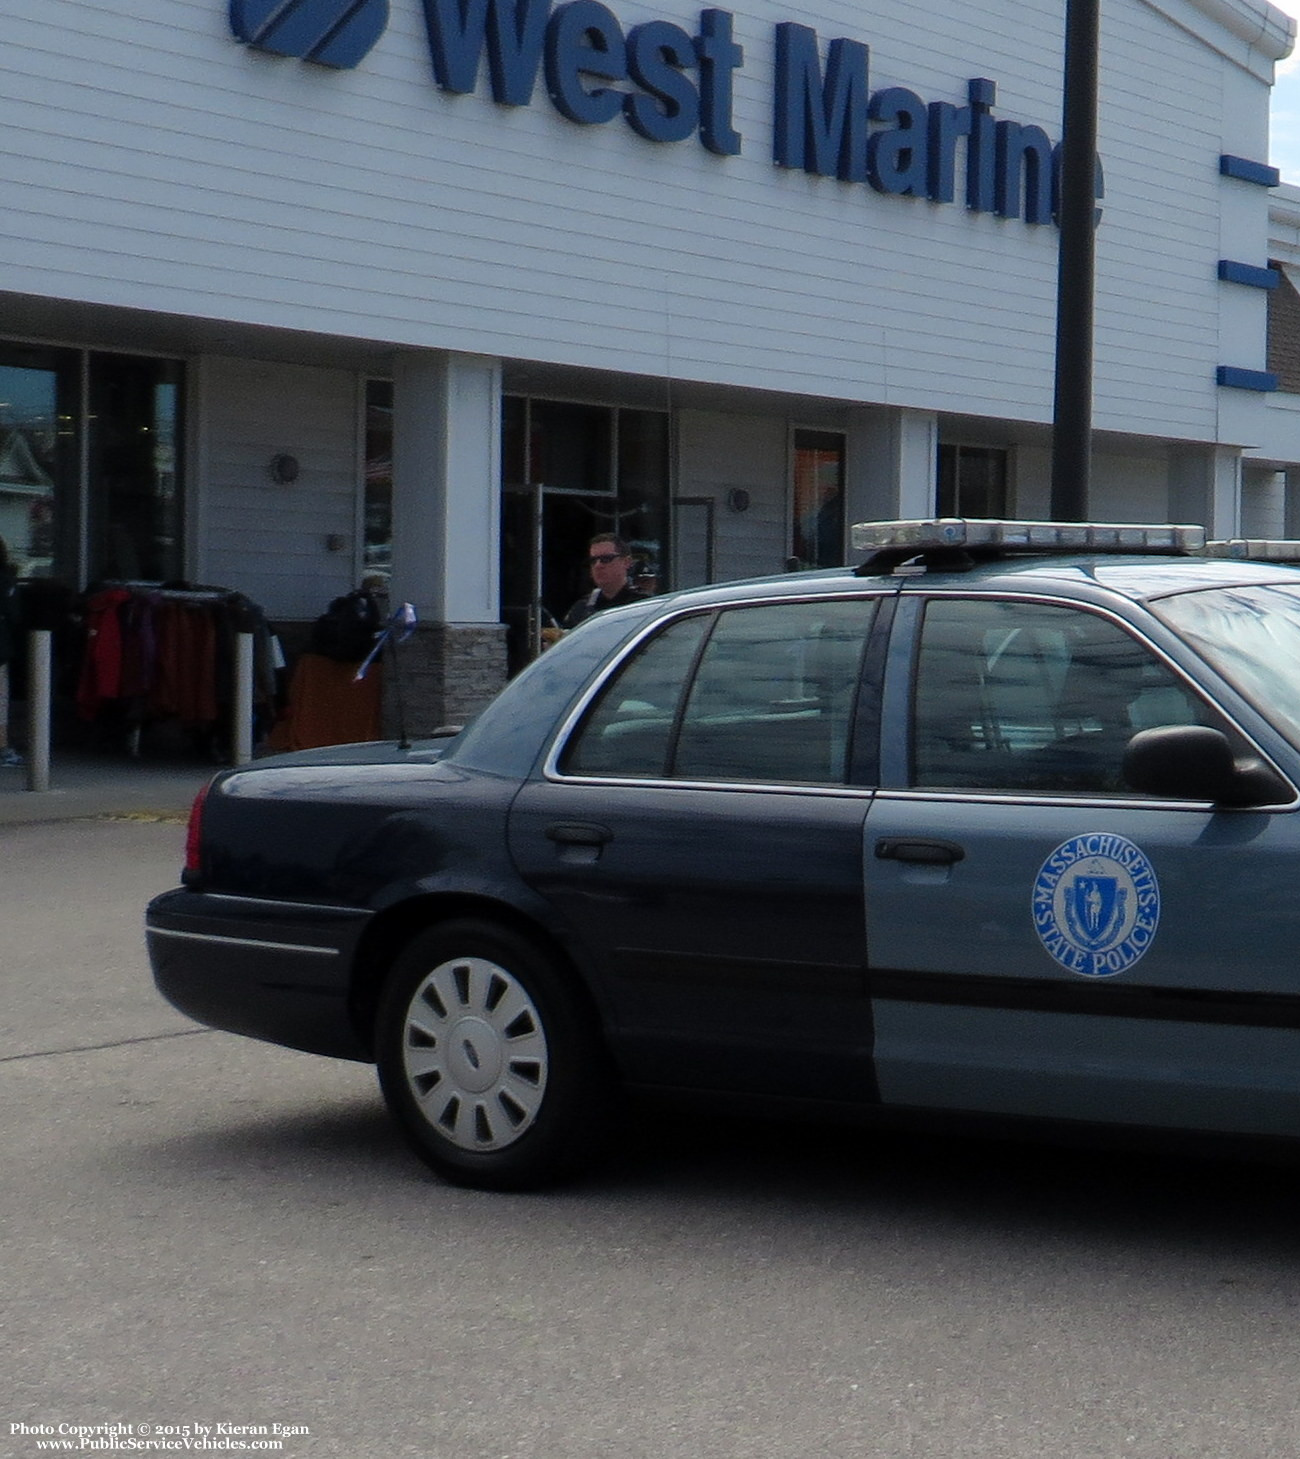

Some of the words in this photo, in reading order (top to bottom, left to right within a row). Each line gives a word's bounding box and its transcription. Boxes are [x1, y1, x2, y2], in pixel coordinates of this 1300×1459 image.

[422, 0, 743, 156] West
[1036, 836, 1157, 907] MASSACHUSETTS
[1036, 910, 1087, 971] STATE
[1093, 913, 1155, 974] POLICE
